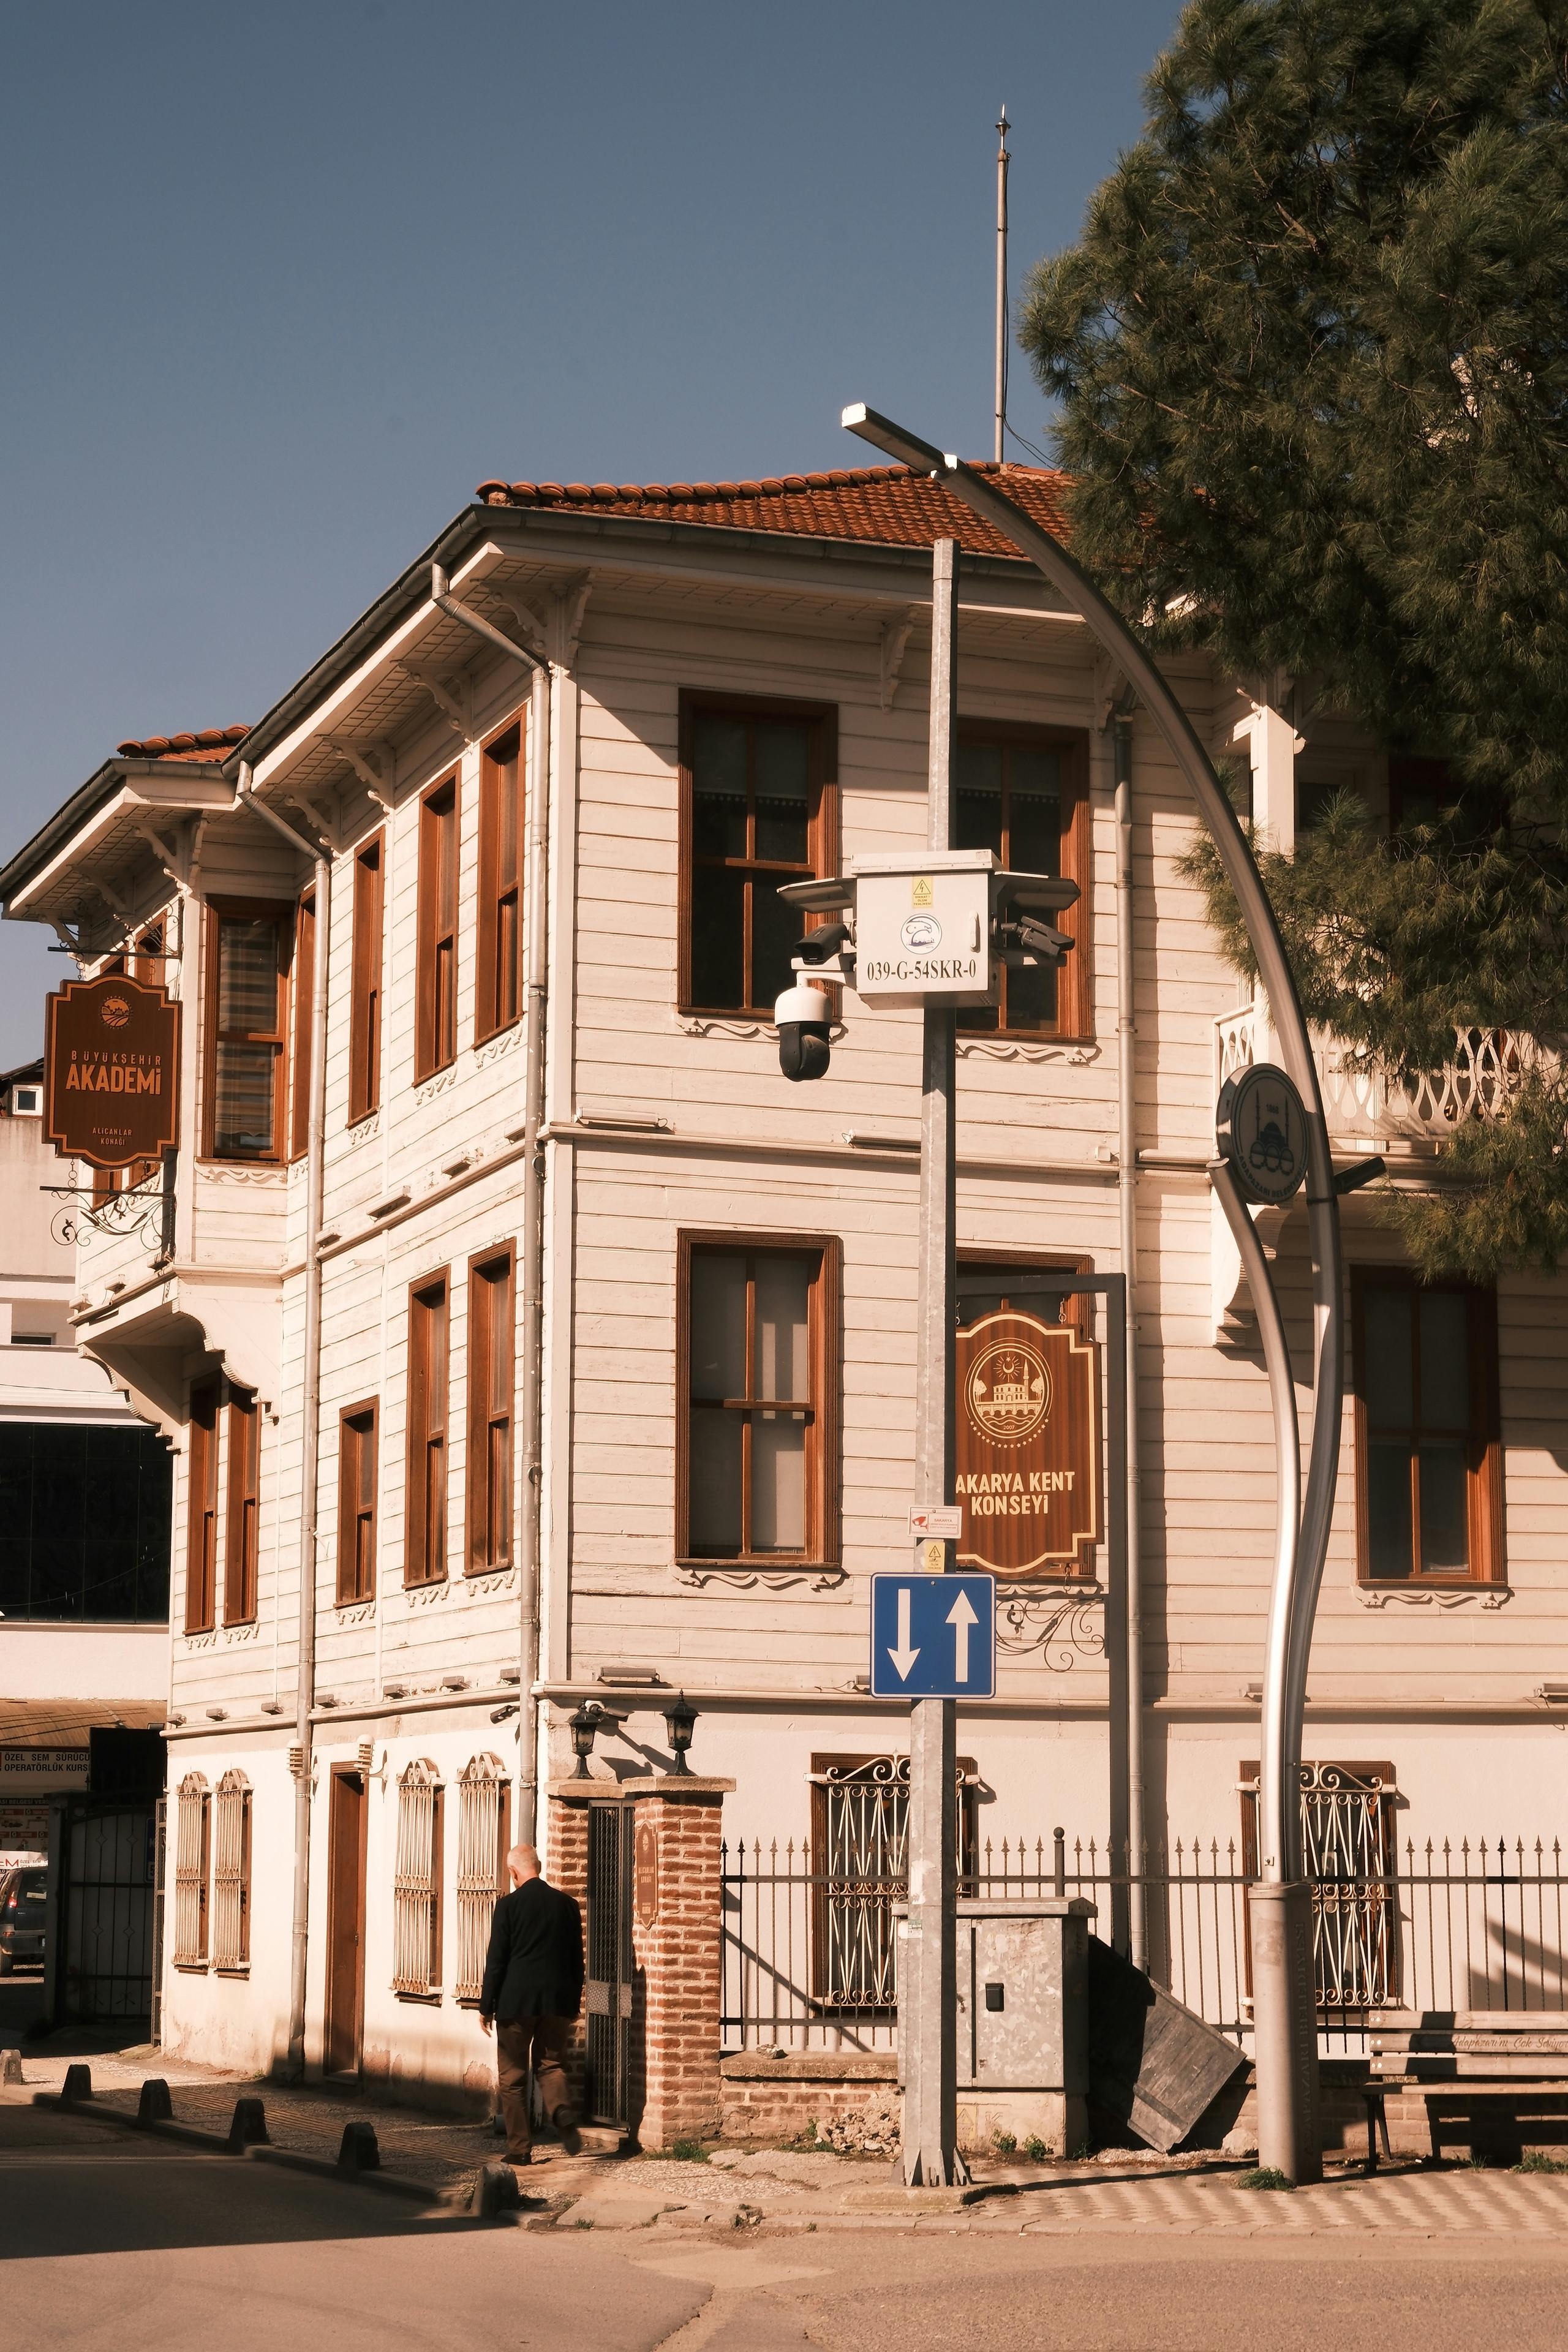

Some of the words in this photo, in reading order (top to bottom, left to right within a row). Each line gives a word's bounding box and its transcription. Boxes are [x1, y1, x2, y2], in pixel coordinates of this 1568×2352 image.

[867, 959, 976, 981] 039-G-54SKR-0
[72, 1050, 161, 1066] BÜYÜKŞEHİR
[66, 1063, 161, 1095] AKADEMİ
[956, 1473, 1024, 1494] AKARYA
[1030, 1471, 1075, 1492] KENT
[971, 1494, 1048, 1516] KONSEYİ
[5, 1752, 25, 1761] ÖZEL
[4, 1762, 63, 1771] OPERATÖRLÜK
[1514, 2037, 1532, 2050] Çok
